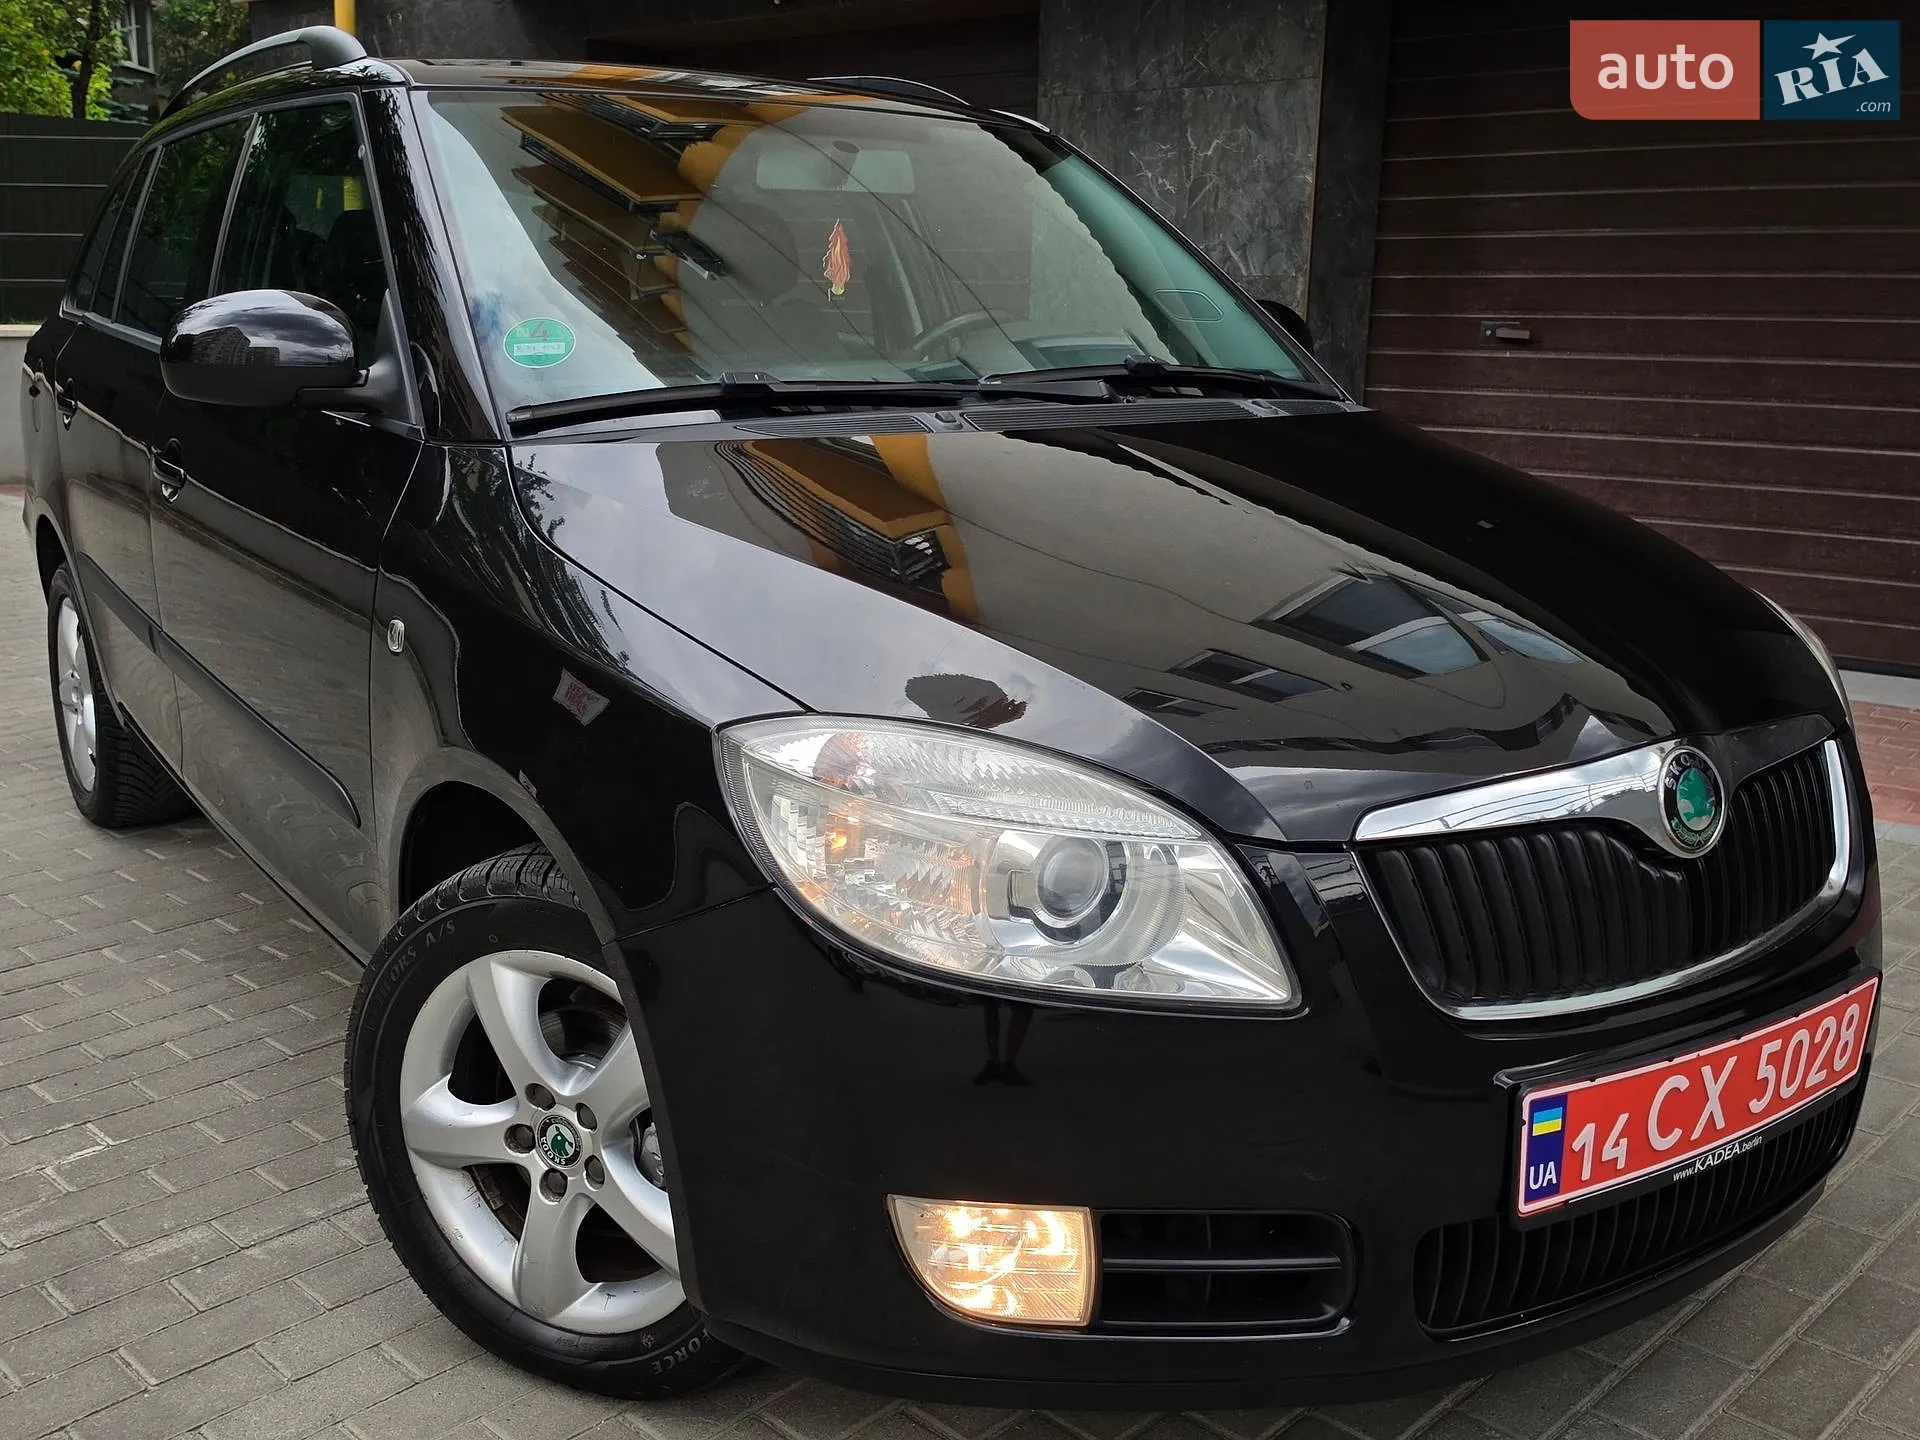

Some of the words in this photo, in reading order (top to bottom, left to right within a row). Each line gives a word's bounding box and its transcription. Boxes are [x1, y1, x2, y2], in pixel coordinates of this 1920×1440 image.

[1571, 1112, 1630, 1181] 14
[1647, 1056, 1738, 1152] CX
[1748, 1002, 1861, 1115] 5028
[1528, 1160, 1558, 1191] UA
[1672, 1135, 1763, 1182] www.KADEA.berlin
